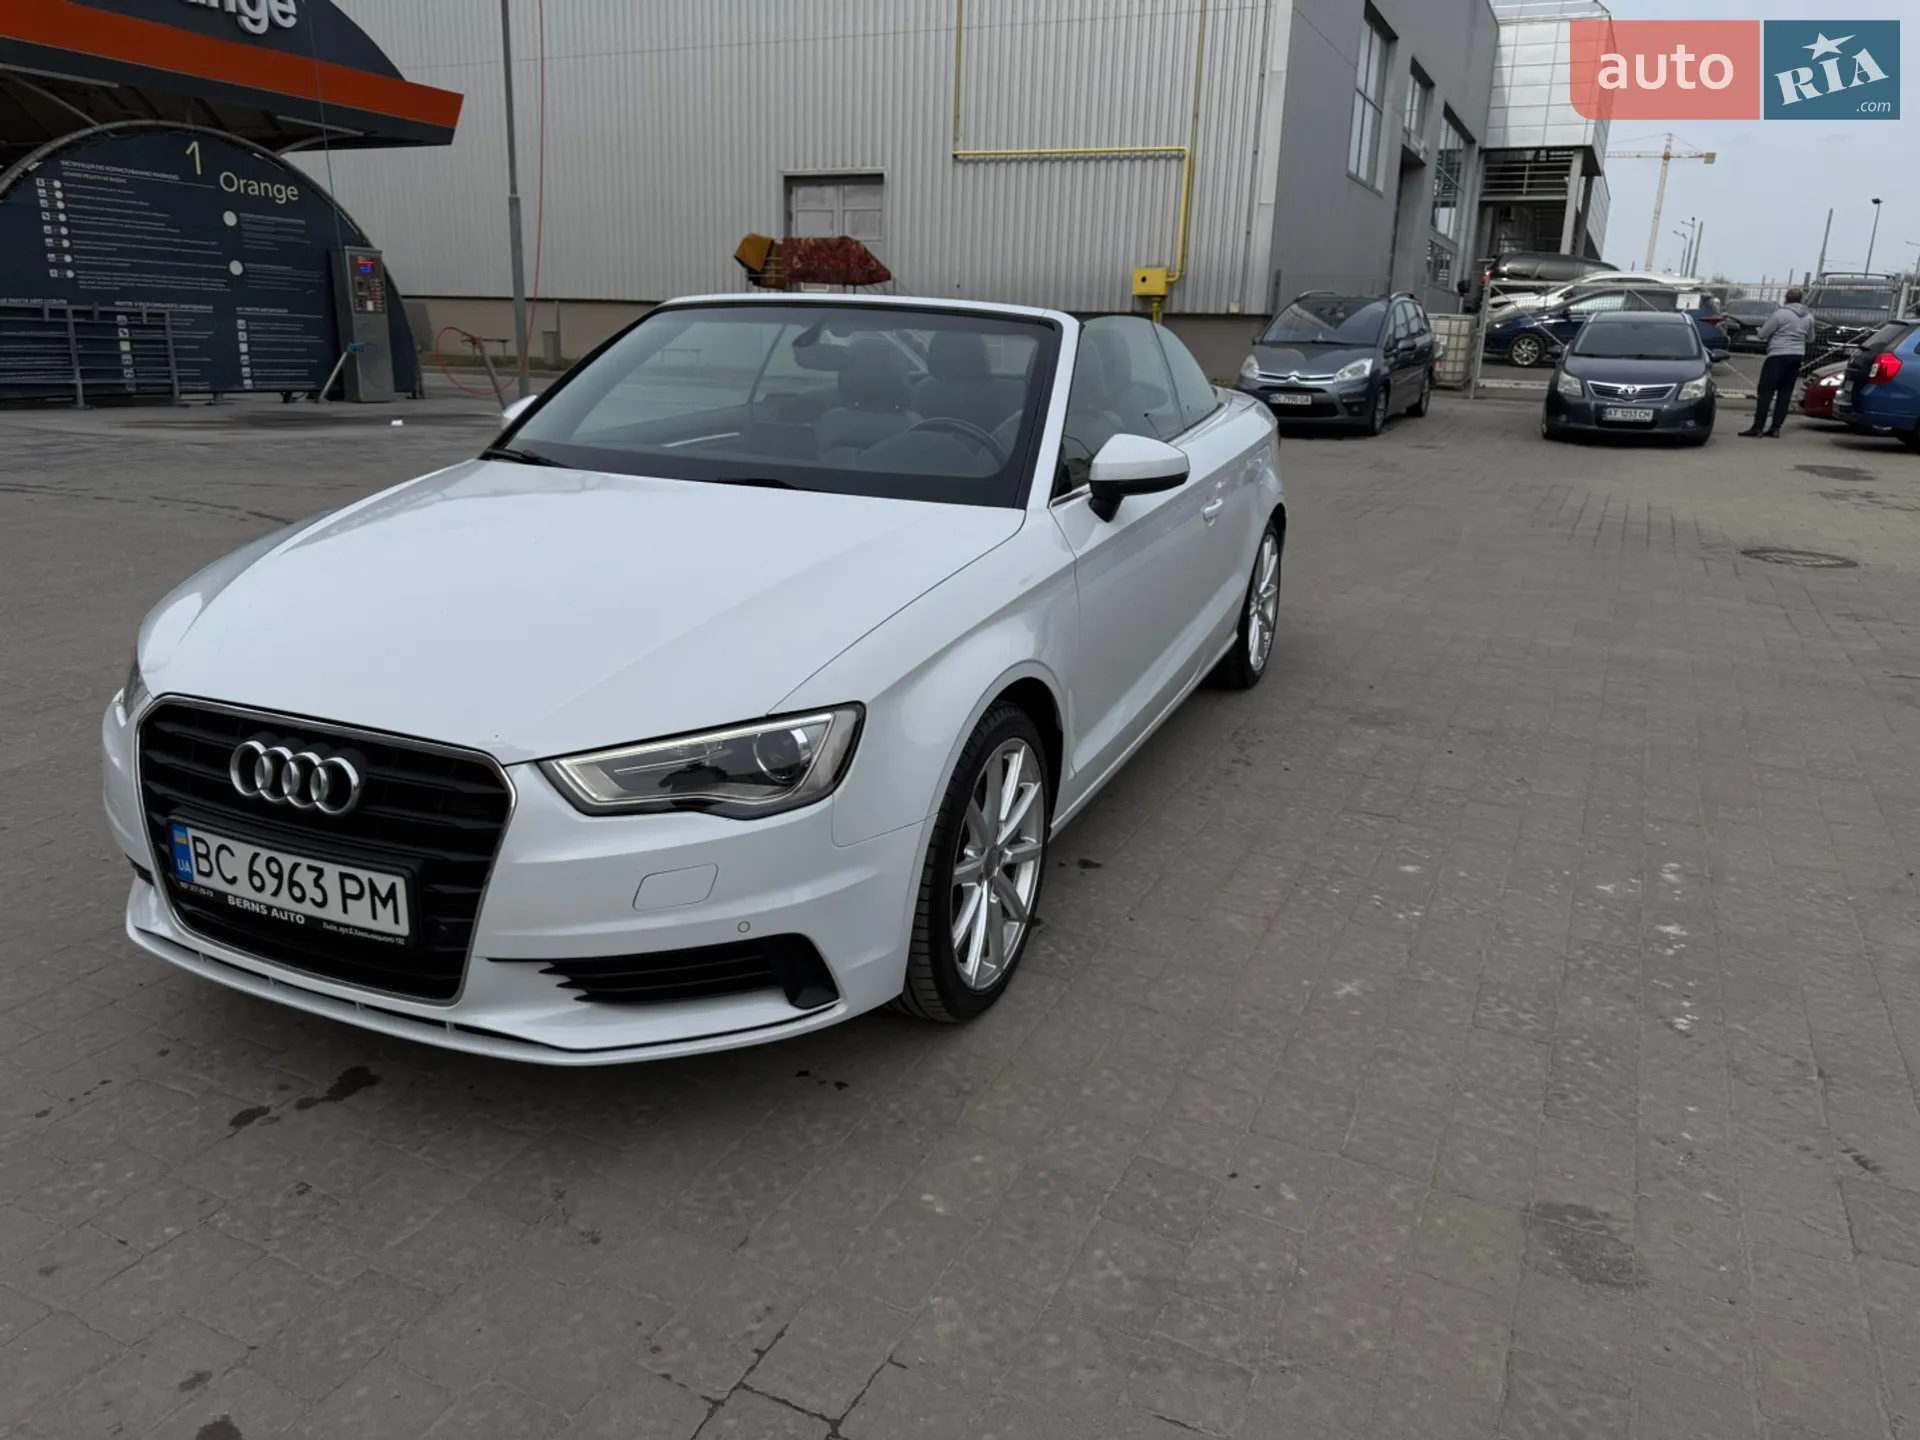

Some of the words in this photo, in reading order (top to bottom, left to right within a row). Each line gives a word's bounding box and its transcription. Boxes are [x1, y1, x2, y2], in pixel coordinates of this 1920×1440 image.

[185, 141, 202, 175] 1
[219, 171, 299, 204] Orange
[177, 859, 192, 874] UA
[192, 835, 238, 885] BC
[248, 852, 329, 909] 6963
[339, 872, 400, 925] PM
[227, 894, 268, 915] BERNS
[271, 907, 306, 925] AUTO
